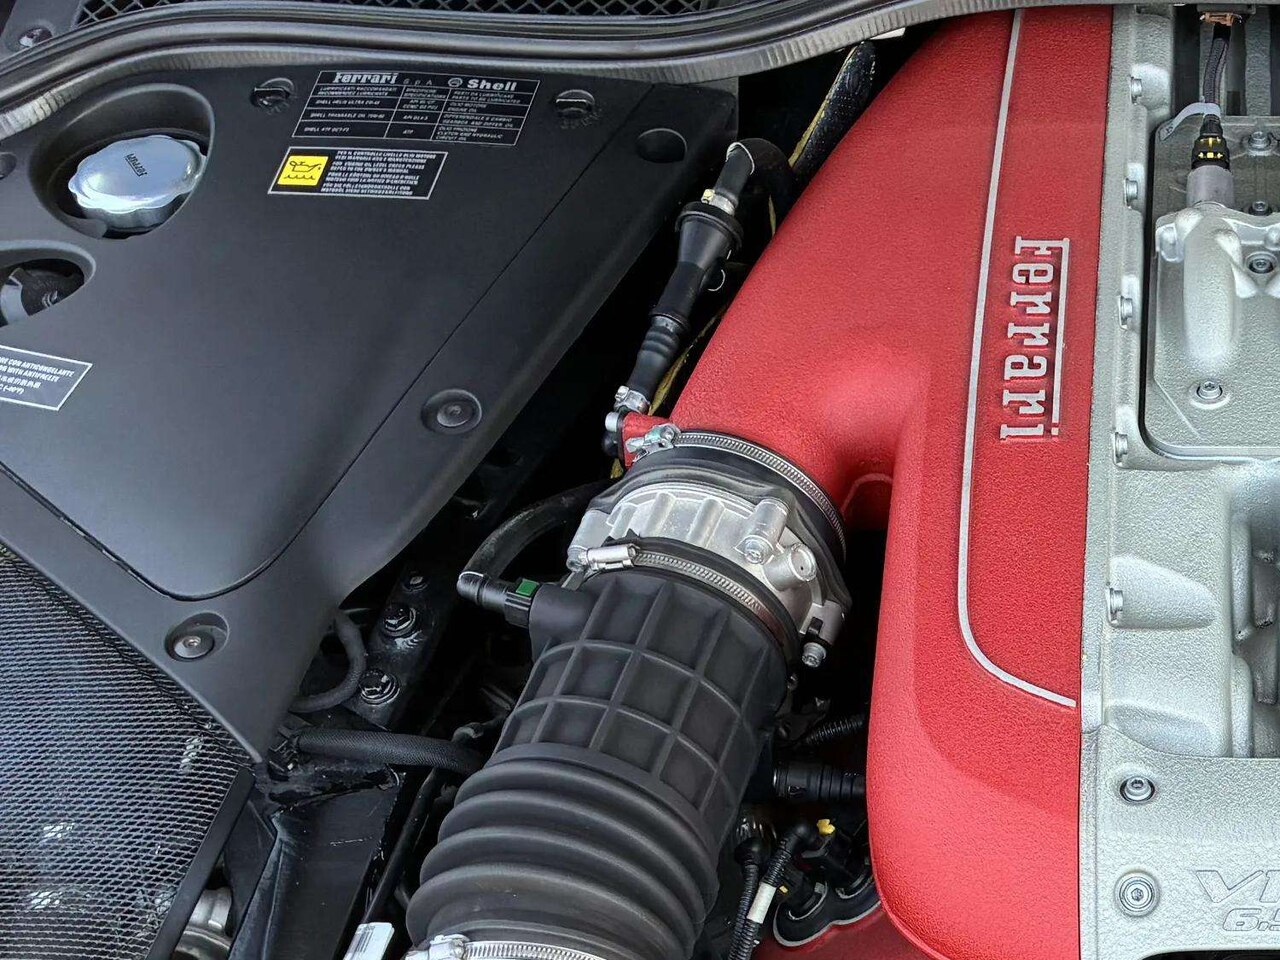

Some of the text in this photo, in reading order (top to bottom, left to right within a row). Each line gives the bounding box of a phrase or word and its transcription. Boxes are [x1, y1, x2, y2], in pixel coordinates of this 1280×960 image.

[332, 72, 400, 84] Ferrari
[467, 79, 517, 91] Shell
[1001, 235, 1071, 441] Ferrari
